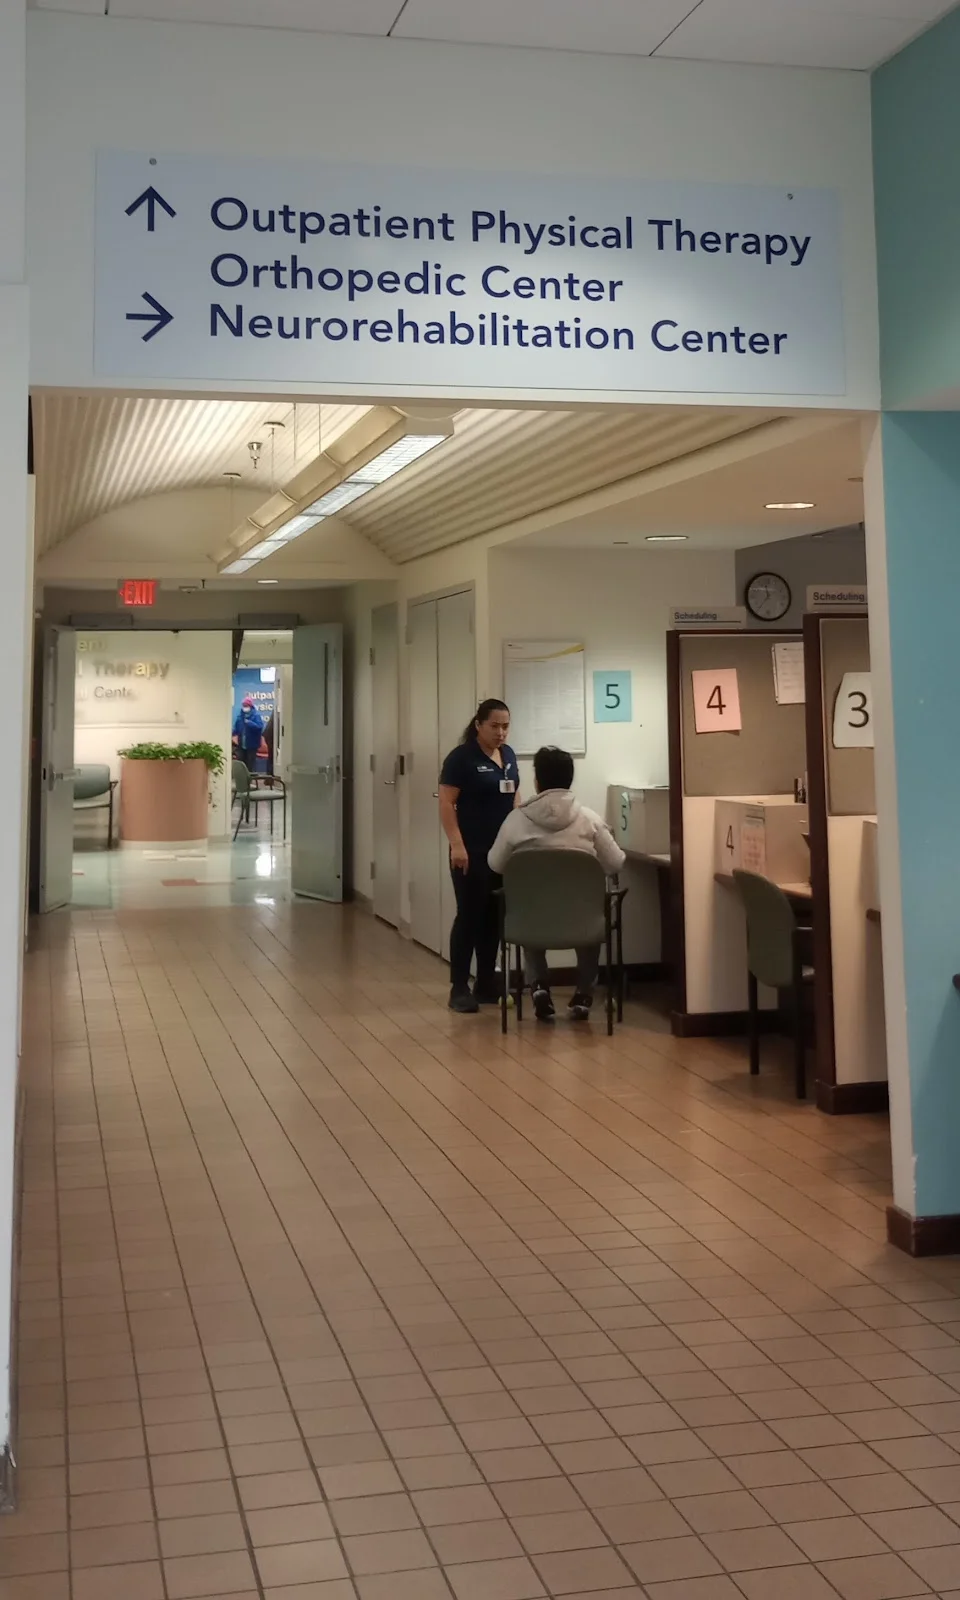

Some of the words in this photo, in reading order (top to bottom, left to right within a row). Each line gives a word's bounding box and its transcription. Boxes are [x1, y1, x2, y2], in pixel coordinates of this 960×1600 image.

[210, 196, 454, 242] Outpatient
[472, 210, 633, 255] Physical
[648, 219, 812, 267] Therapy
[210, 252, 466, 302] Orthopedic
[482, 265, 623, 303] Center
[210, 303, 634, 350] Neurorehabilitation
[652, 319, 788, 355] Center
[124, 581, 156, 605] EXIT
[813, 591, 865, 602] Scheduling
[674, 611, 718, 621] Scheduling
[93, 660, 170, 680] Therapy
[604, 683, 621, 709] 5
[706, 685, 727, 715] 4
[847, 691, 870, 728] 3
[620, 805, 628, 831] 5
[726, 825, 735, 856] 4
